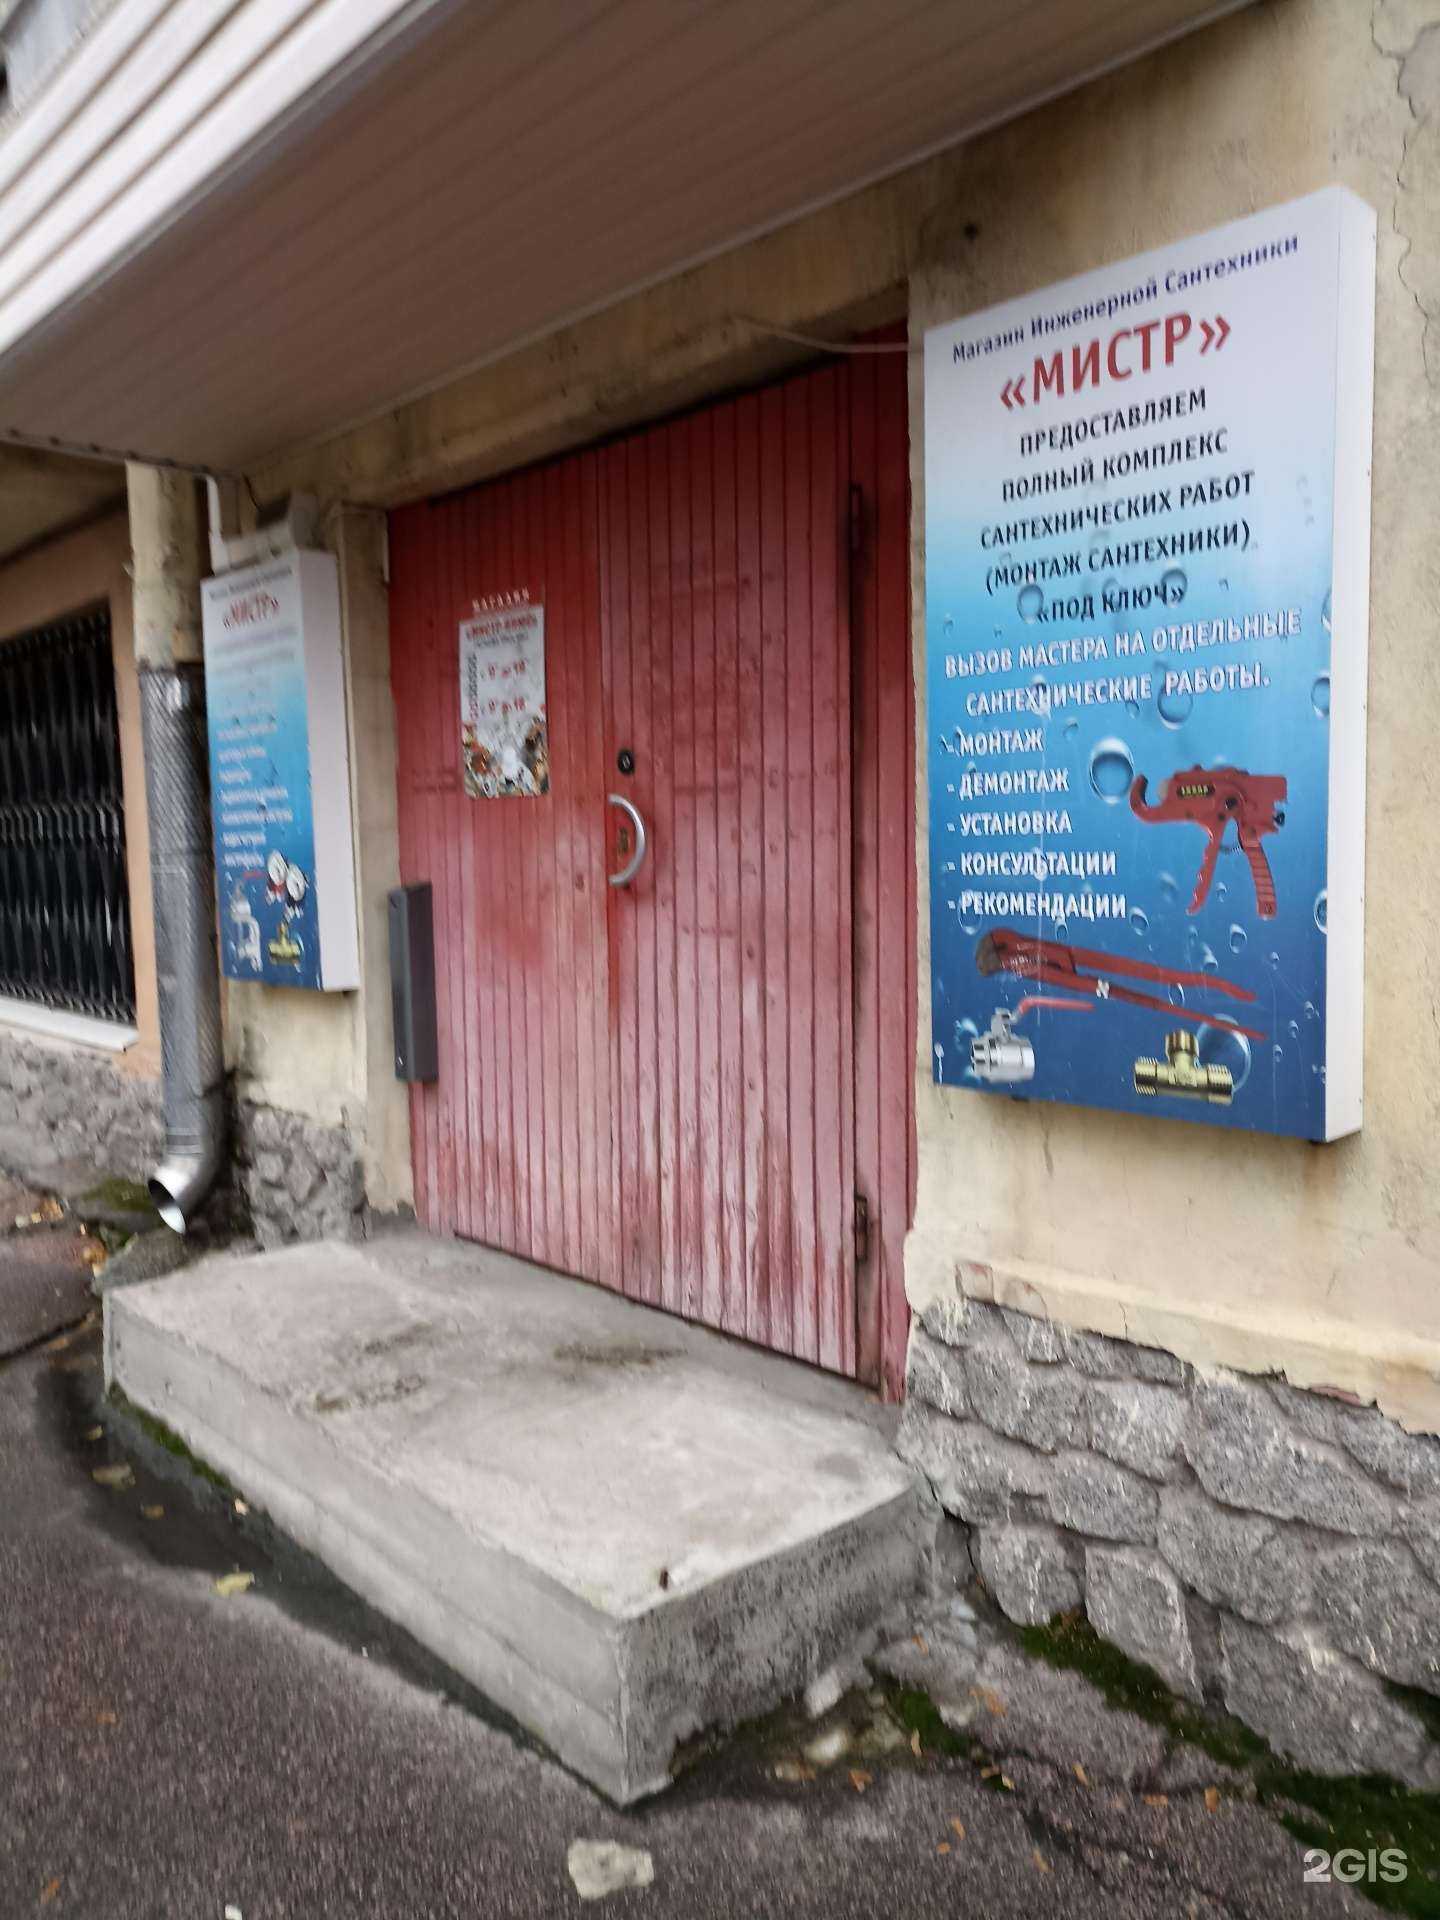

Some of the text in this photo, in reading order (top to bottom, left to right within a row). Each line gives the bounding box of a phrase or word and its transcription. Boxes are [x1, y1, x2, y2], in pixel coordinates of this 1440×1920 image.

[952, 234, 1299, 363] Магазин Инженерной Сантехники
[1000, 312, 1231, 410] «МИСТР»
[1020, 388, 1206, 457] ПРЕДОСТАВЛЯЕМ
[1002, 428, 1228, 503] ПОЛНЫЙ КОМПЛЕКС
[980, 471, 1255, 550] САНТЕХНИЧЕСКИХ РАБОТ
[985, 518, 1250, 596] (МОНТАЖ САНТЕХНИКИ)
[1102, 583, 1186, 614] КЛЮЧ»
[945, 607, 1302, 679] ВЫЗОВ МАСТЕРА НА ОТДЕЛЬНЫЕ
[965, 663, 1271, 718] САНТЕХНИЧЕСКИЕ РАБОТЫ.
[959, 726, 1044, 756] МОНТАЖ
[958, 768, 1071, 801] ДЕМОНТАЖ
[959, 810, 1073, 837] УСТАНОВКА
[960, 850, 1117, 880] КОНСУЛЬТАЦИИ
[960, 890, 1127, 921] РЕКОМЕНДАЦИИ
